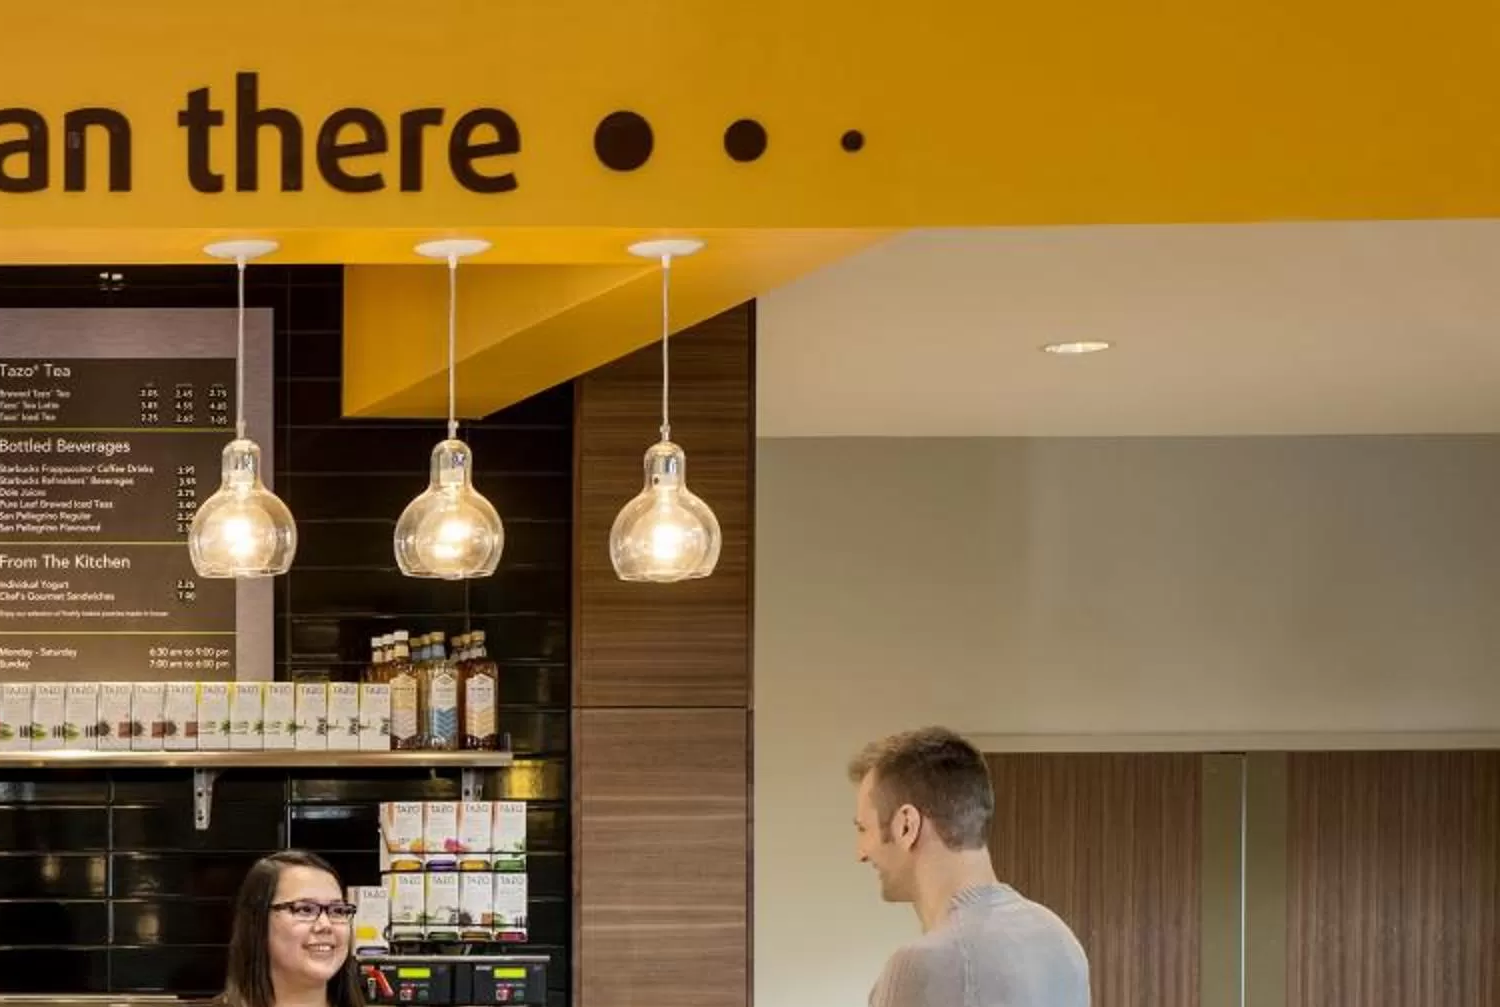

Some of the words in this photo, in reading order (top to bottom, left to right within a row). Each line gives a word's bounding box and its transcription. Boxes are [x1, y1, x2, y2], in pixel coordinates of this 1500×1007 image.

[177, 71, 522, 193] there
[43, 363, 71, 377] Tea
[56, 438, 131, 456] Beverages
[41, 553, 70, 569] The
[74, 553, 131, 569] Kitchen
[0, 648, 33, 658] Monday
